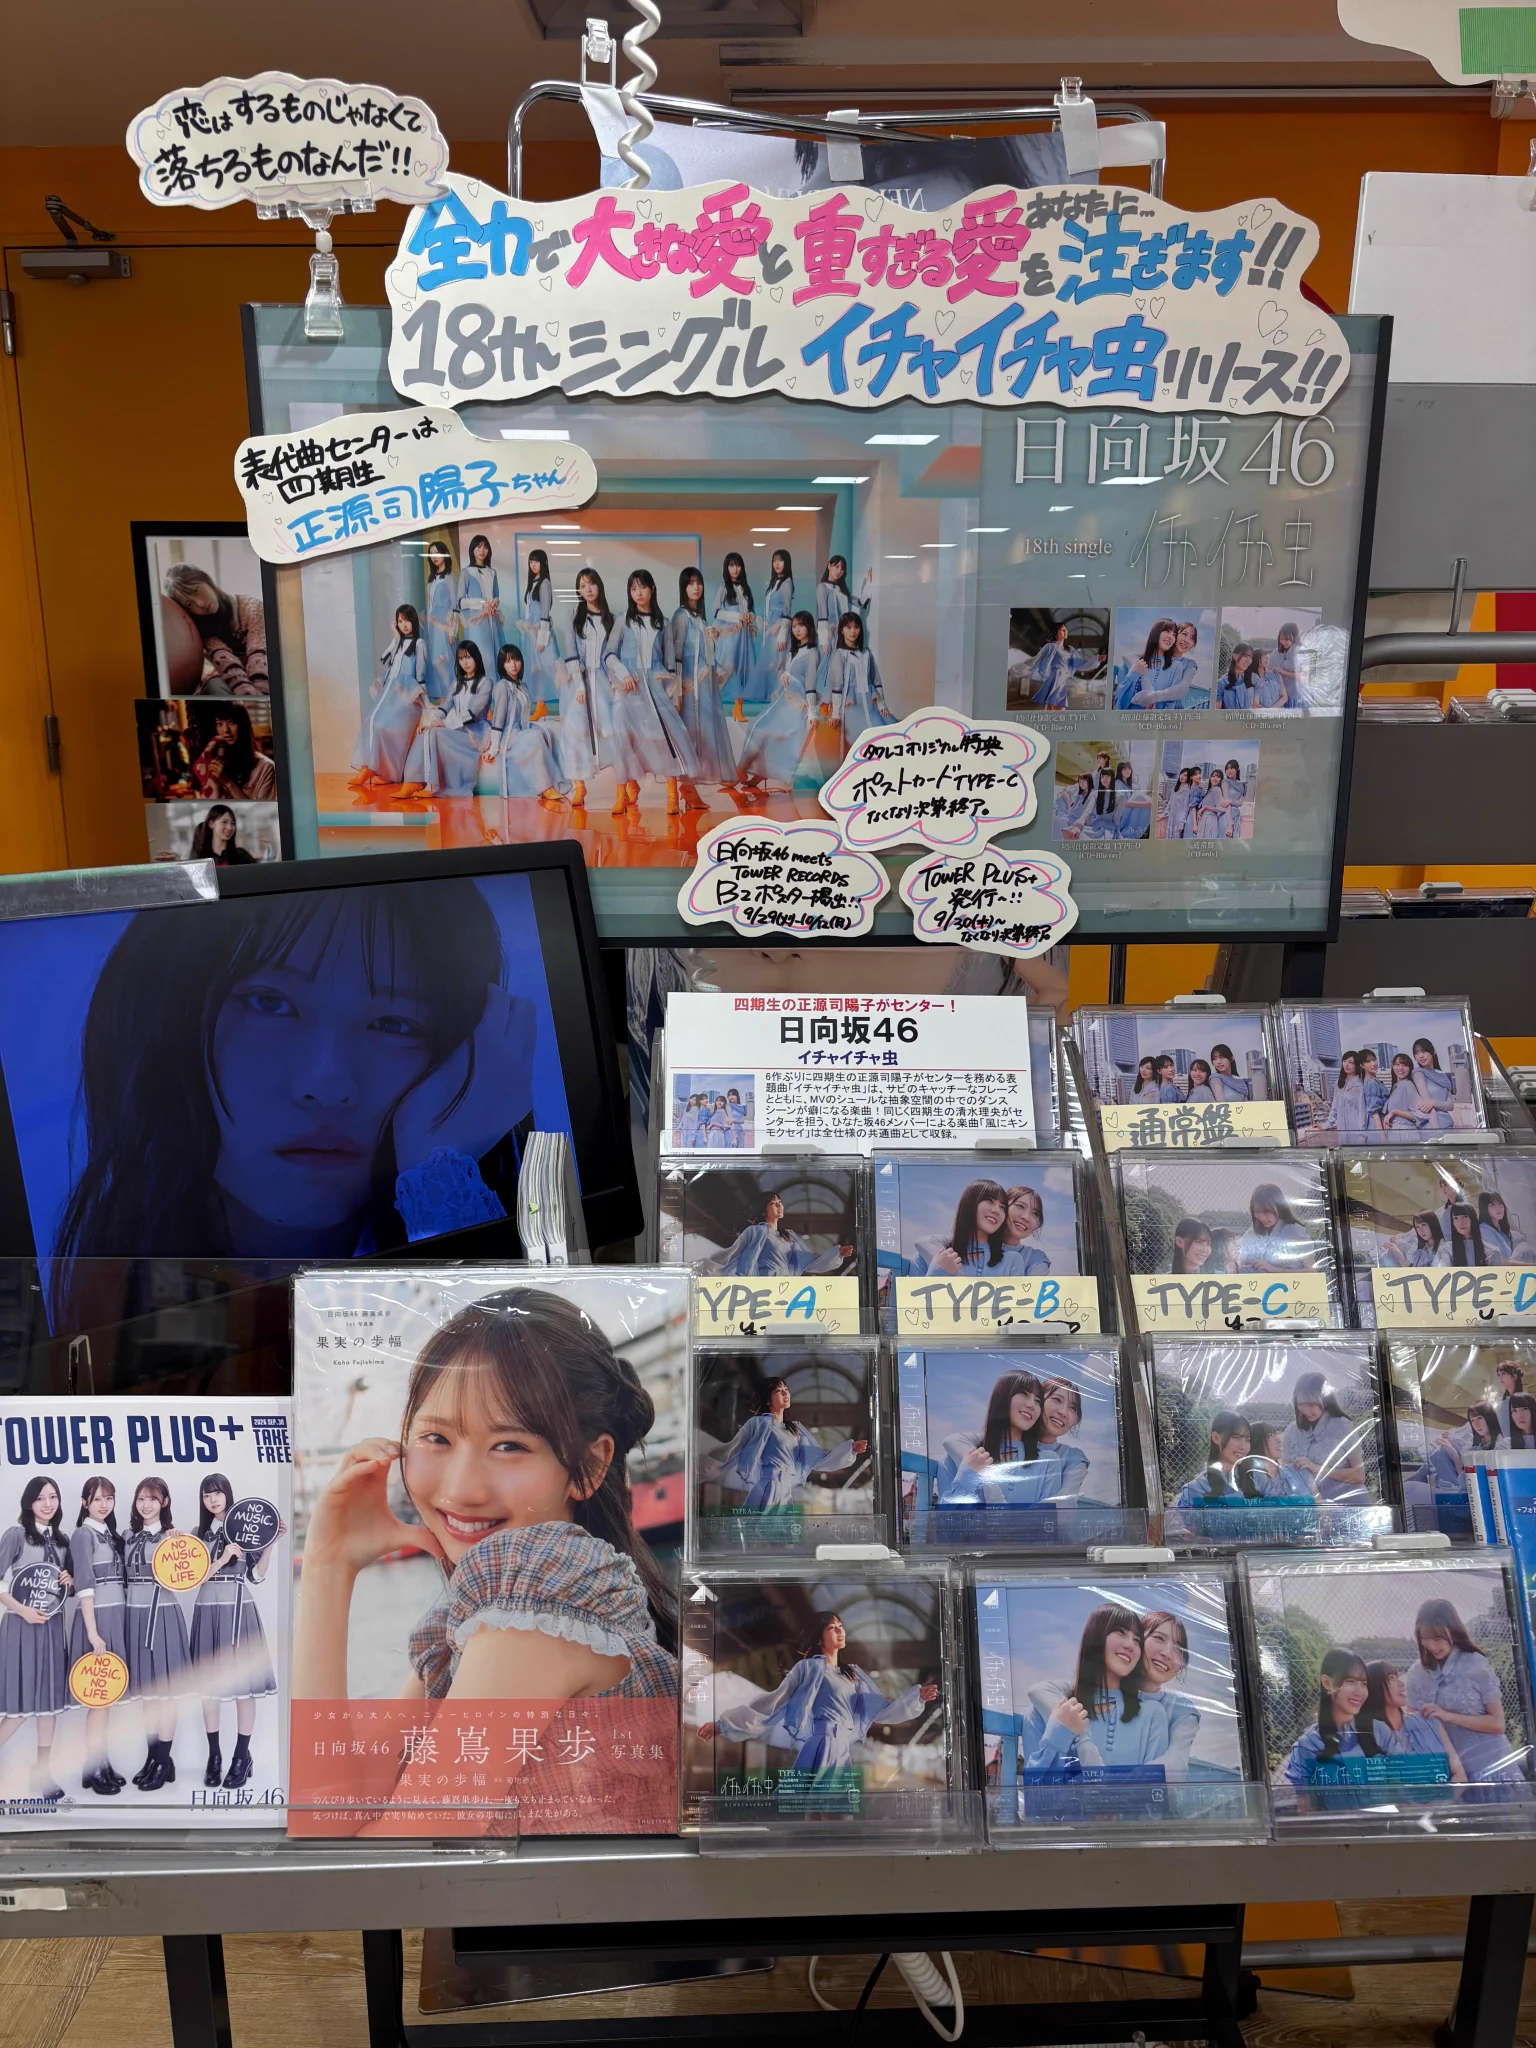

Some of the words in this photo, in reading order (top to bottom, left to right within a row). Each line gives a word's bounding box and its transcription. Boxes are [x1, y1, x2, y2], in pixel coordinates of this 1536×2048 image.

[173, 90, 423, 137] 恋はするものじゃなくて
[276, 460, 387, 505] 四期生
[287, 460, 568, 553] 正源司陽子ちゃん
[1023, 537, 1060, 555] 18th
[1064, 537, 1113, 558] single
[791, 850, 834, 867] meets
[779, 1015, 919, 1045] 日向坂46
[797, 1049, 899, 1067] イチャイチャ虫
[1127, 1103, 1240, 1147] 通常盤
[700, 1284, 818, 1323] YPE-A
[909, 1279, 1061, 1324] TYPE-B
[1146, 1281, 1290, 1320] TYPE-C
[316, 1334, 402, 1349] 果実の歩幅
[0, 1415, 116, 1466] OWER
[253, 1428, 290, 1446] TAKE
[256, 1446, 293, 1464] FREE
[247, 1503, 264, 1513] NO
[242, 1523, 259, 1534] NO
[171, 1539, 187, 1550] NO
[33, 1568, 51, 1578] NO
[174, 1560, 190, 1572] NO
[29, 1589, 47, 1599] NO
[94, 1657, 111, 1667] NO
[90, 1678, 107, 1688] NO
[611, 1728, 633, 1740] 1st
[313, 1740, 390, 1757] 日向坂46
[397, 1725, 597, 1766] 藤嶌果歩
[611, 1744, 665, 1760] 写真集
[1365, 1757, 1383, 1766] TYPE
[400, 1772, 487, 1787] 果実の歩幅
[778, 1769, 796, 1778] TYPE
[637, 1817, 673, 1825] SHUEISHA
